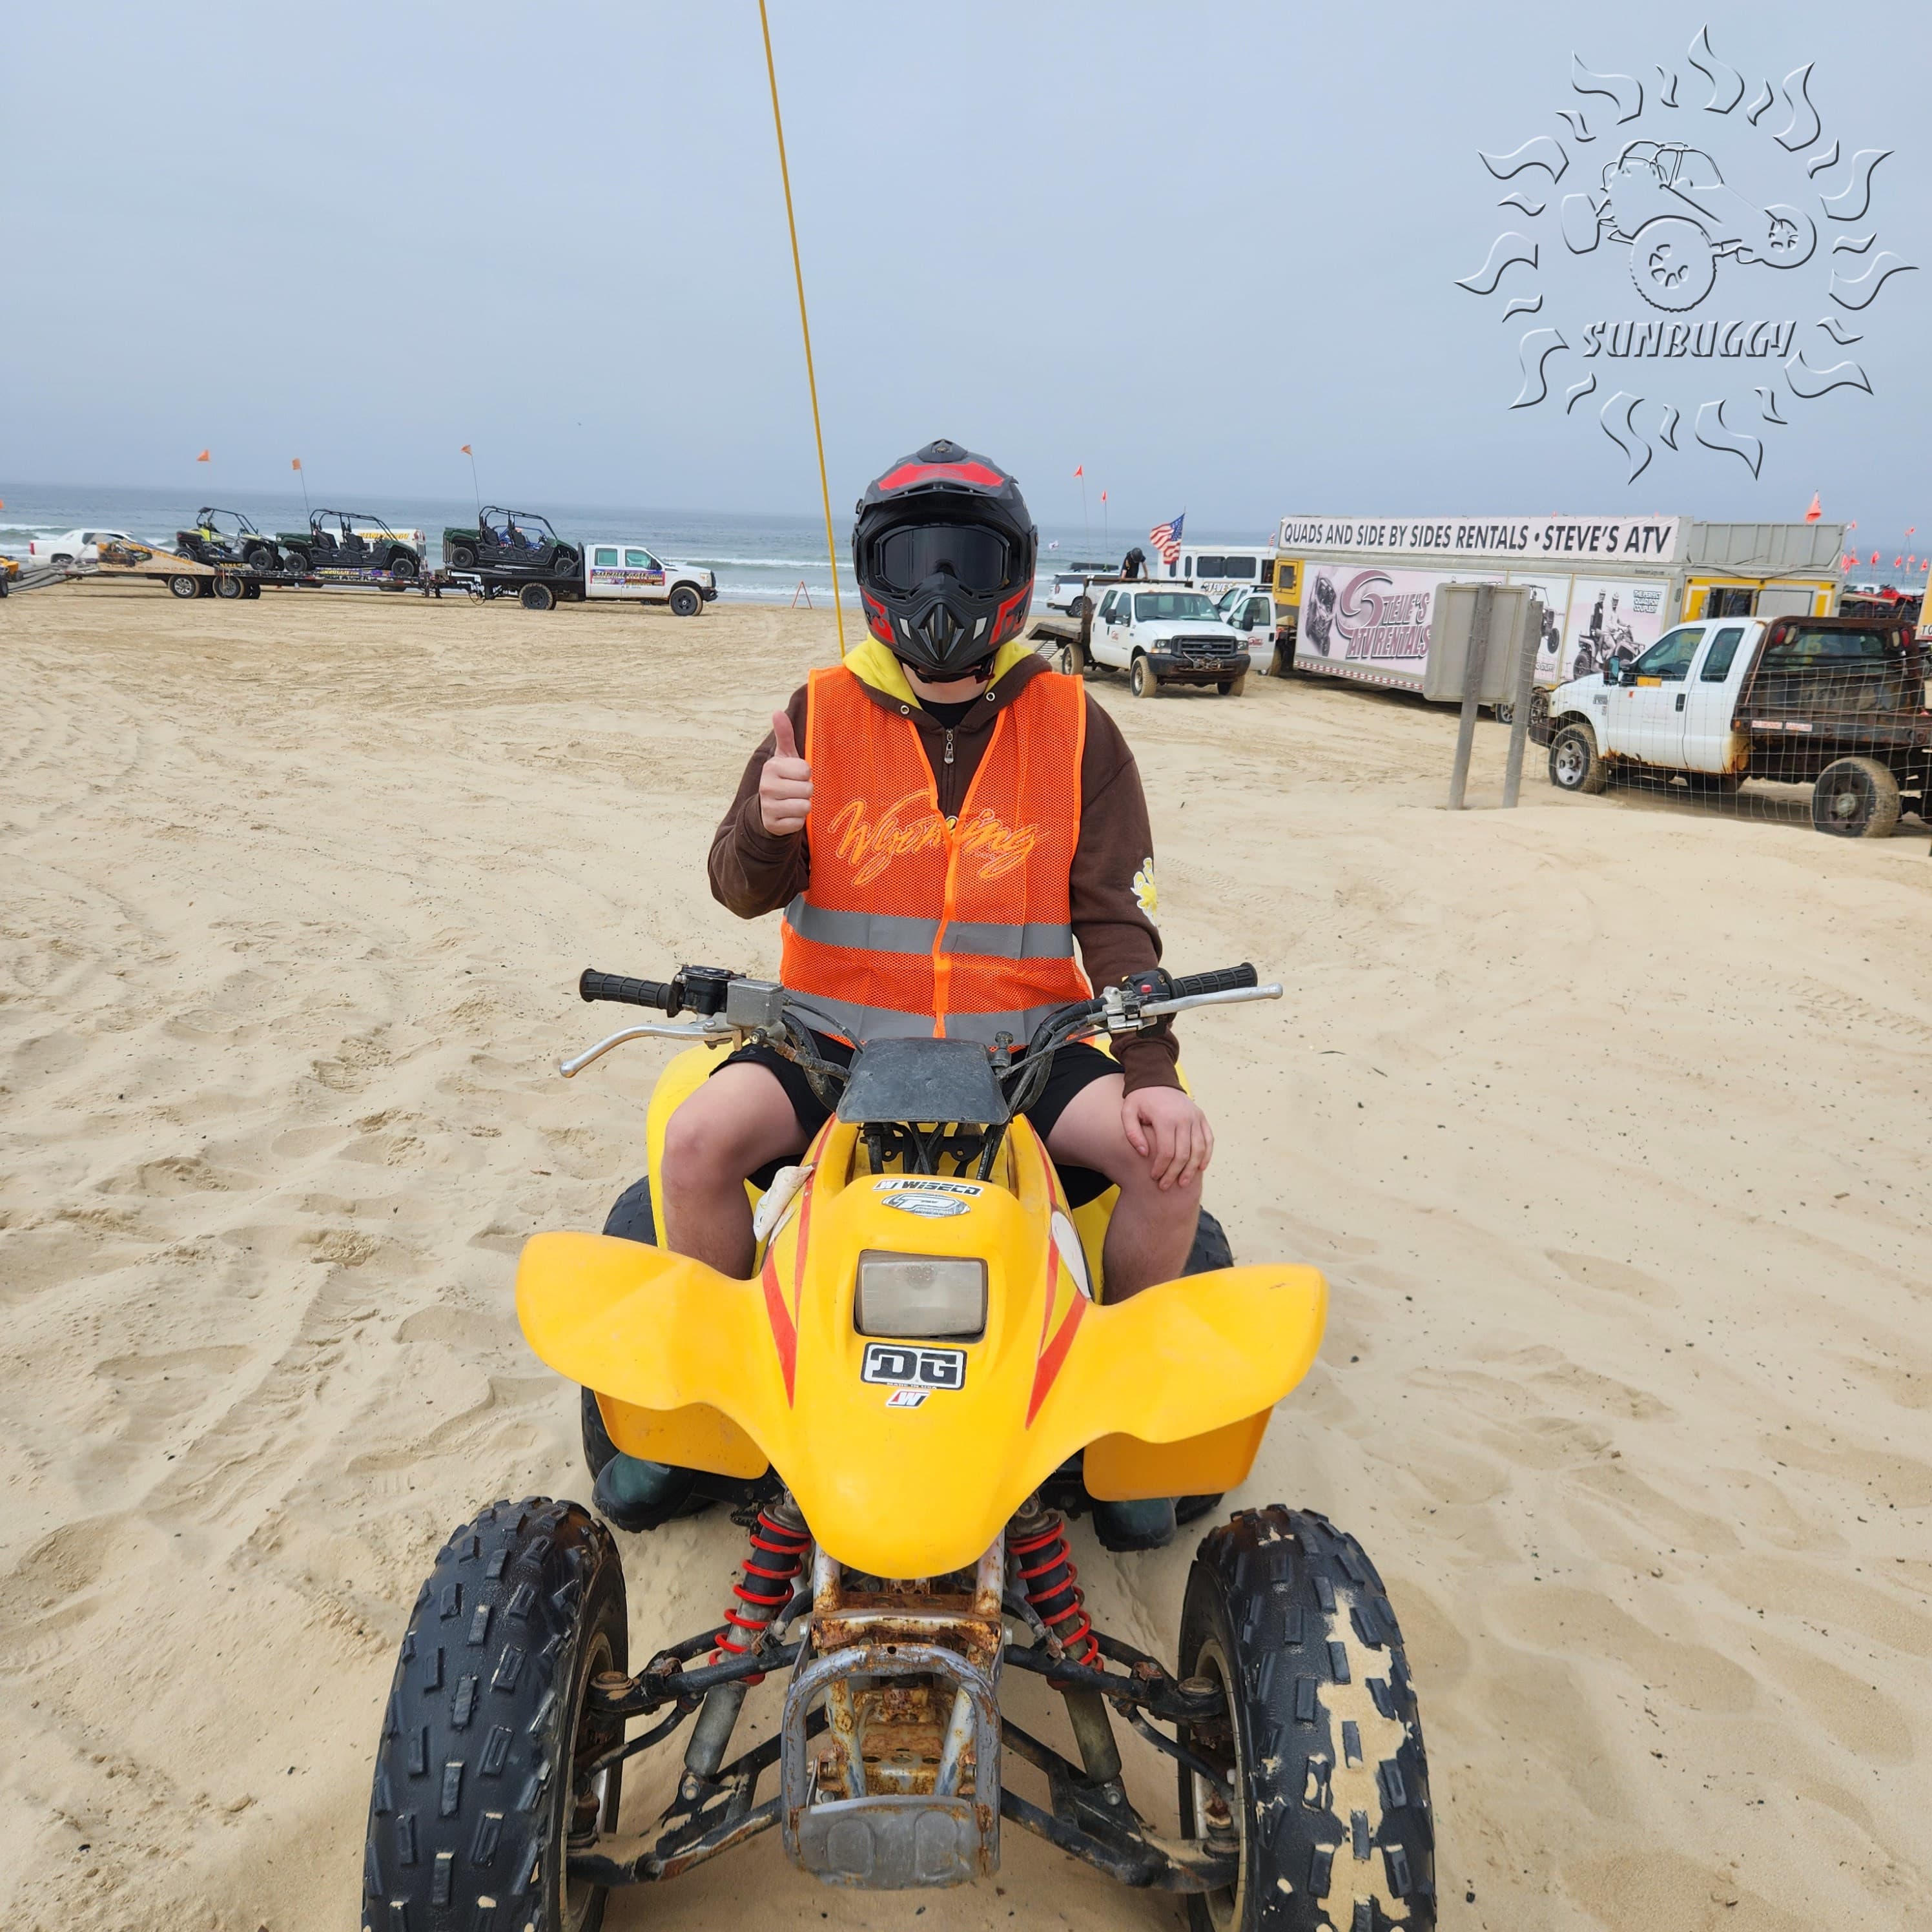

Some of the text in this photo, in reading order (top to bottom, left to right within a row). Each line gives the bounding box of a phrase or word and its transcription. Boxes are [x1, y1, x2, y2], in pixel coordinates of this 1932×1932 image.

[1284, 523, 1672, 554] QUADS AND SIDE BY SIDES RENTALS STEVE'S ATV
[1346, 624, 1432, 659] ATV RENTALS
[870, 1348, 958, 1385] DG
